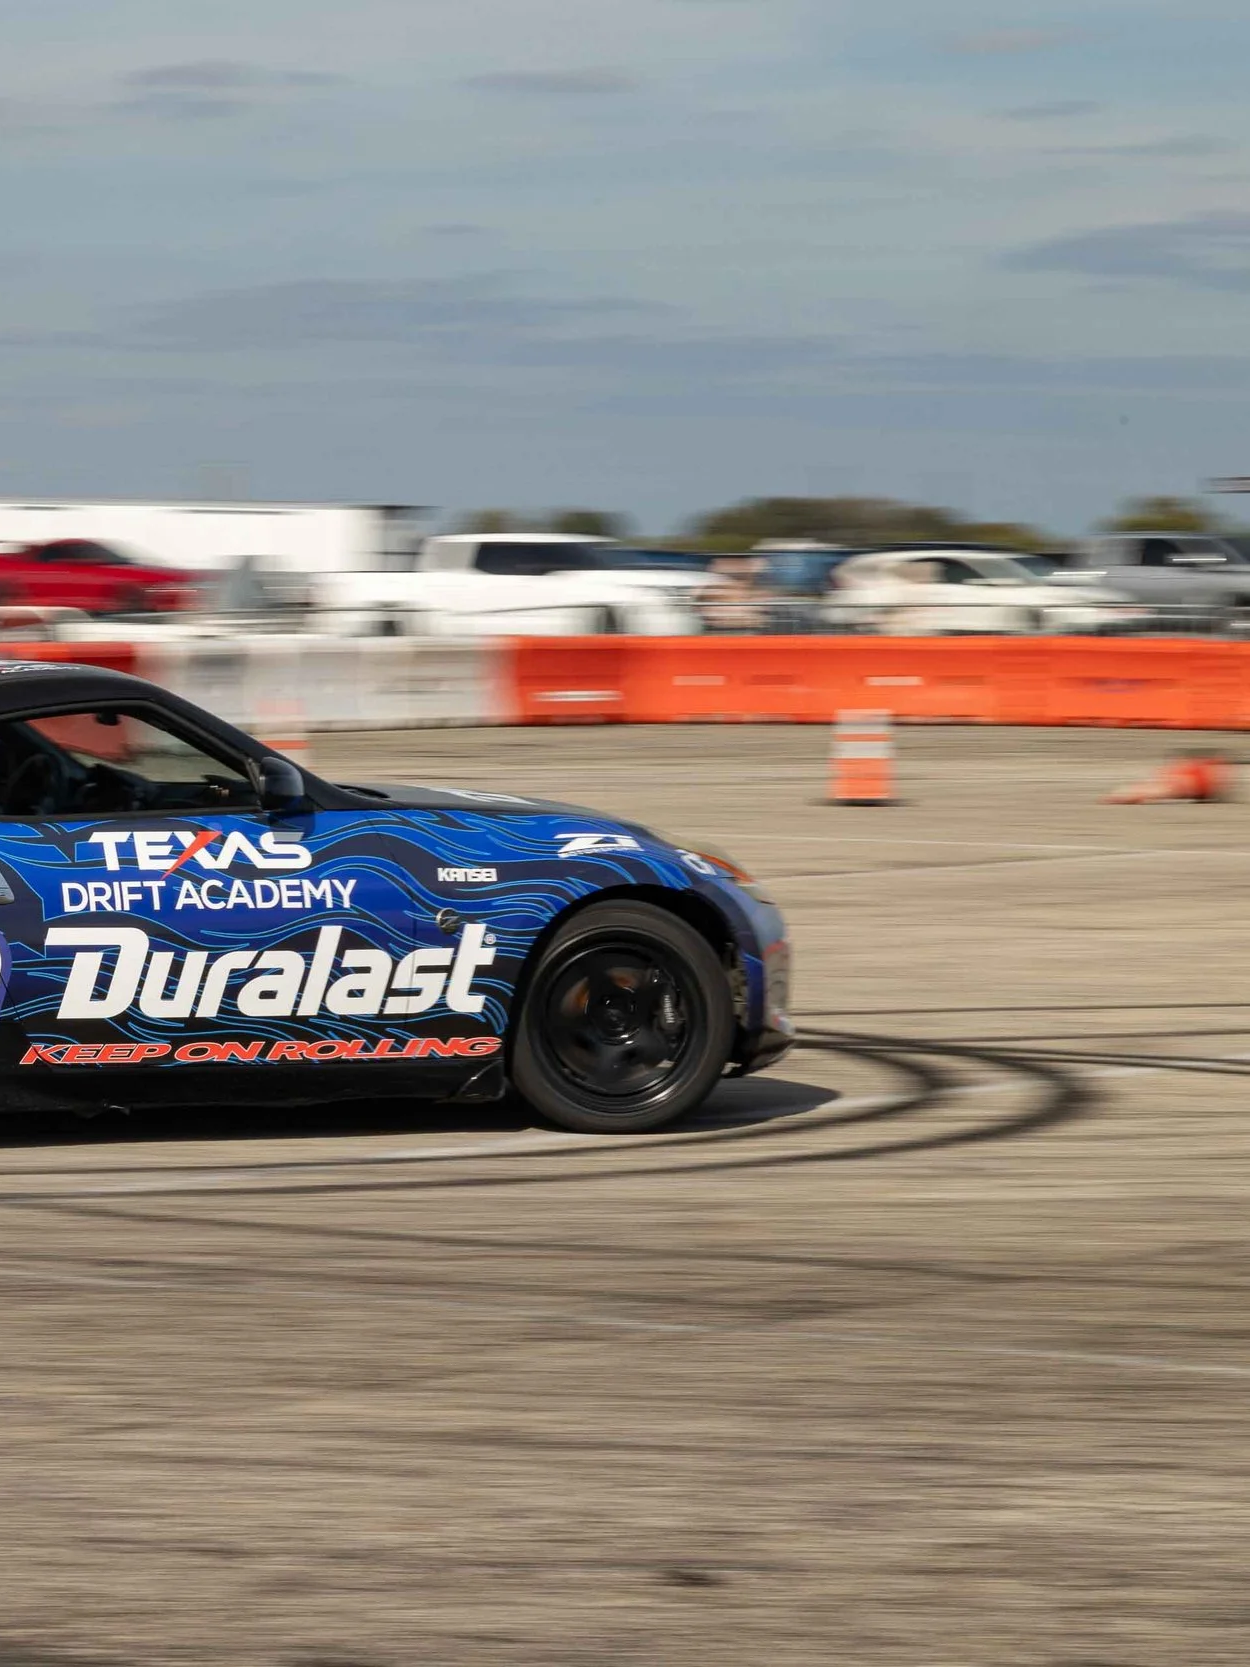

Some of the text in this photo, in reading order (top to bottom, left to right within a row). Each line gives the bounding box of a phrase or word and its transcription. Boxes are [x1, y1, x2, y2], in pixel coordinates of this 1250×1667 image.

[88, 830, 312, 879] TEXAS
[437, 867, 498, 882] KANSEI
[62, 879, 357, 913] DRIFT ACADEMY
[44, 923, 498, 1020] Duralast
[20, 1036, 503, 1065] KEEP ON ROLLING
